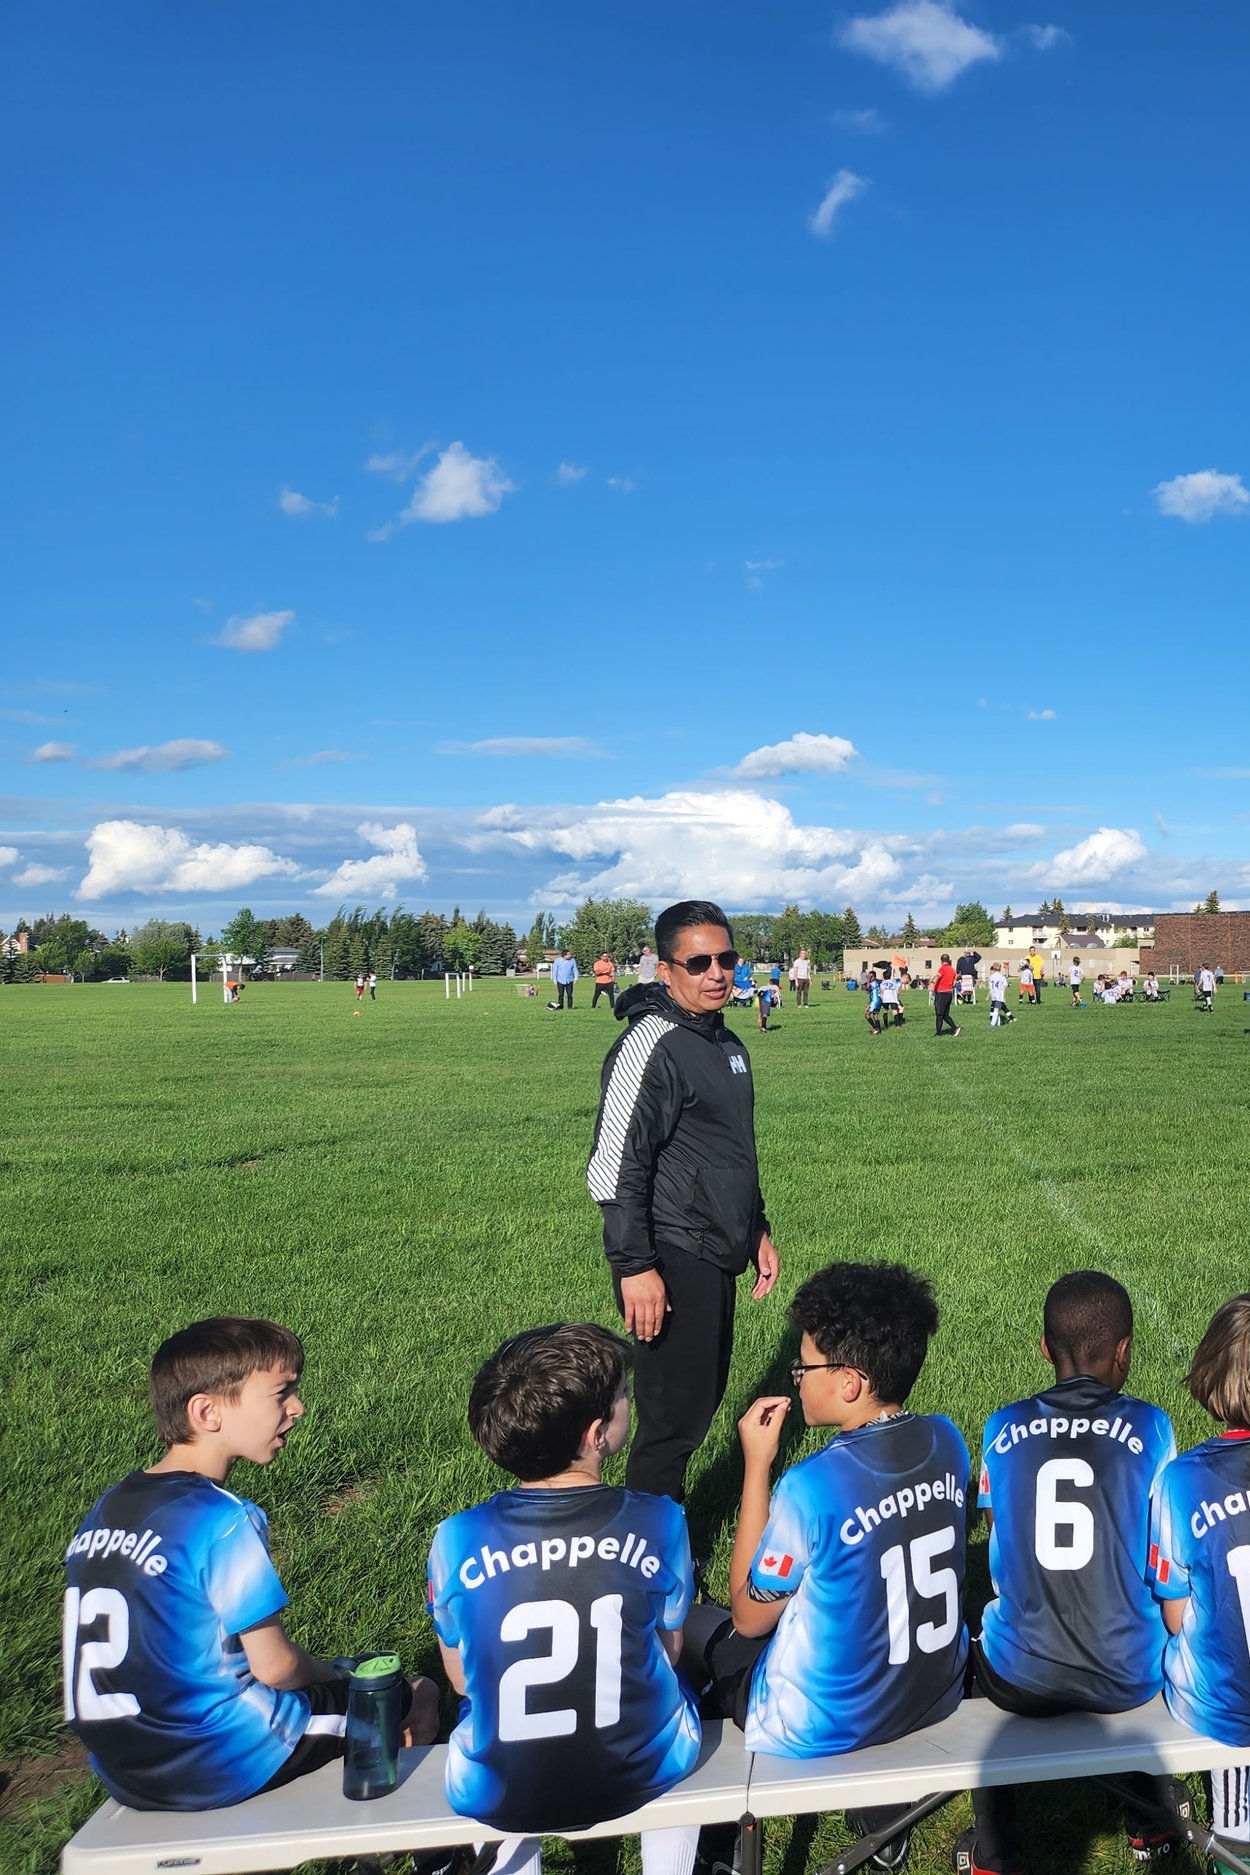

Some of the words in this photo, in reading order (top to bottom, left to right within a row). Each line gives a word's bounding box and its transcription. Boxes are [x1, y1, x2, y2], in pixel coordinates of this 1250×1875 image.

[994, 1416, 1144, 1455] Chappelle
[459, 1532, 661, 1590] Chappelle
[839, 1472, 965, 1545] Chappelle
[1035, 1458, 1095, 1571] 6
[880, 1525, 959, 1666] 15
[63, 1586, 142, 1722] 12
[498, 1593, 624, 1742] 21
